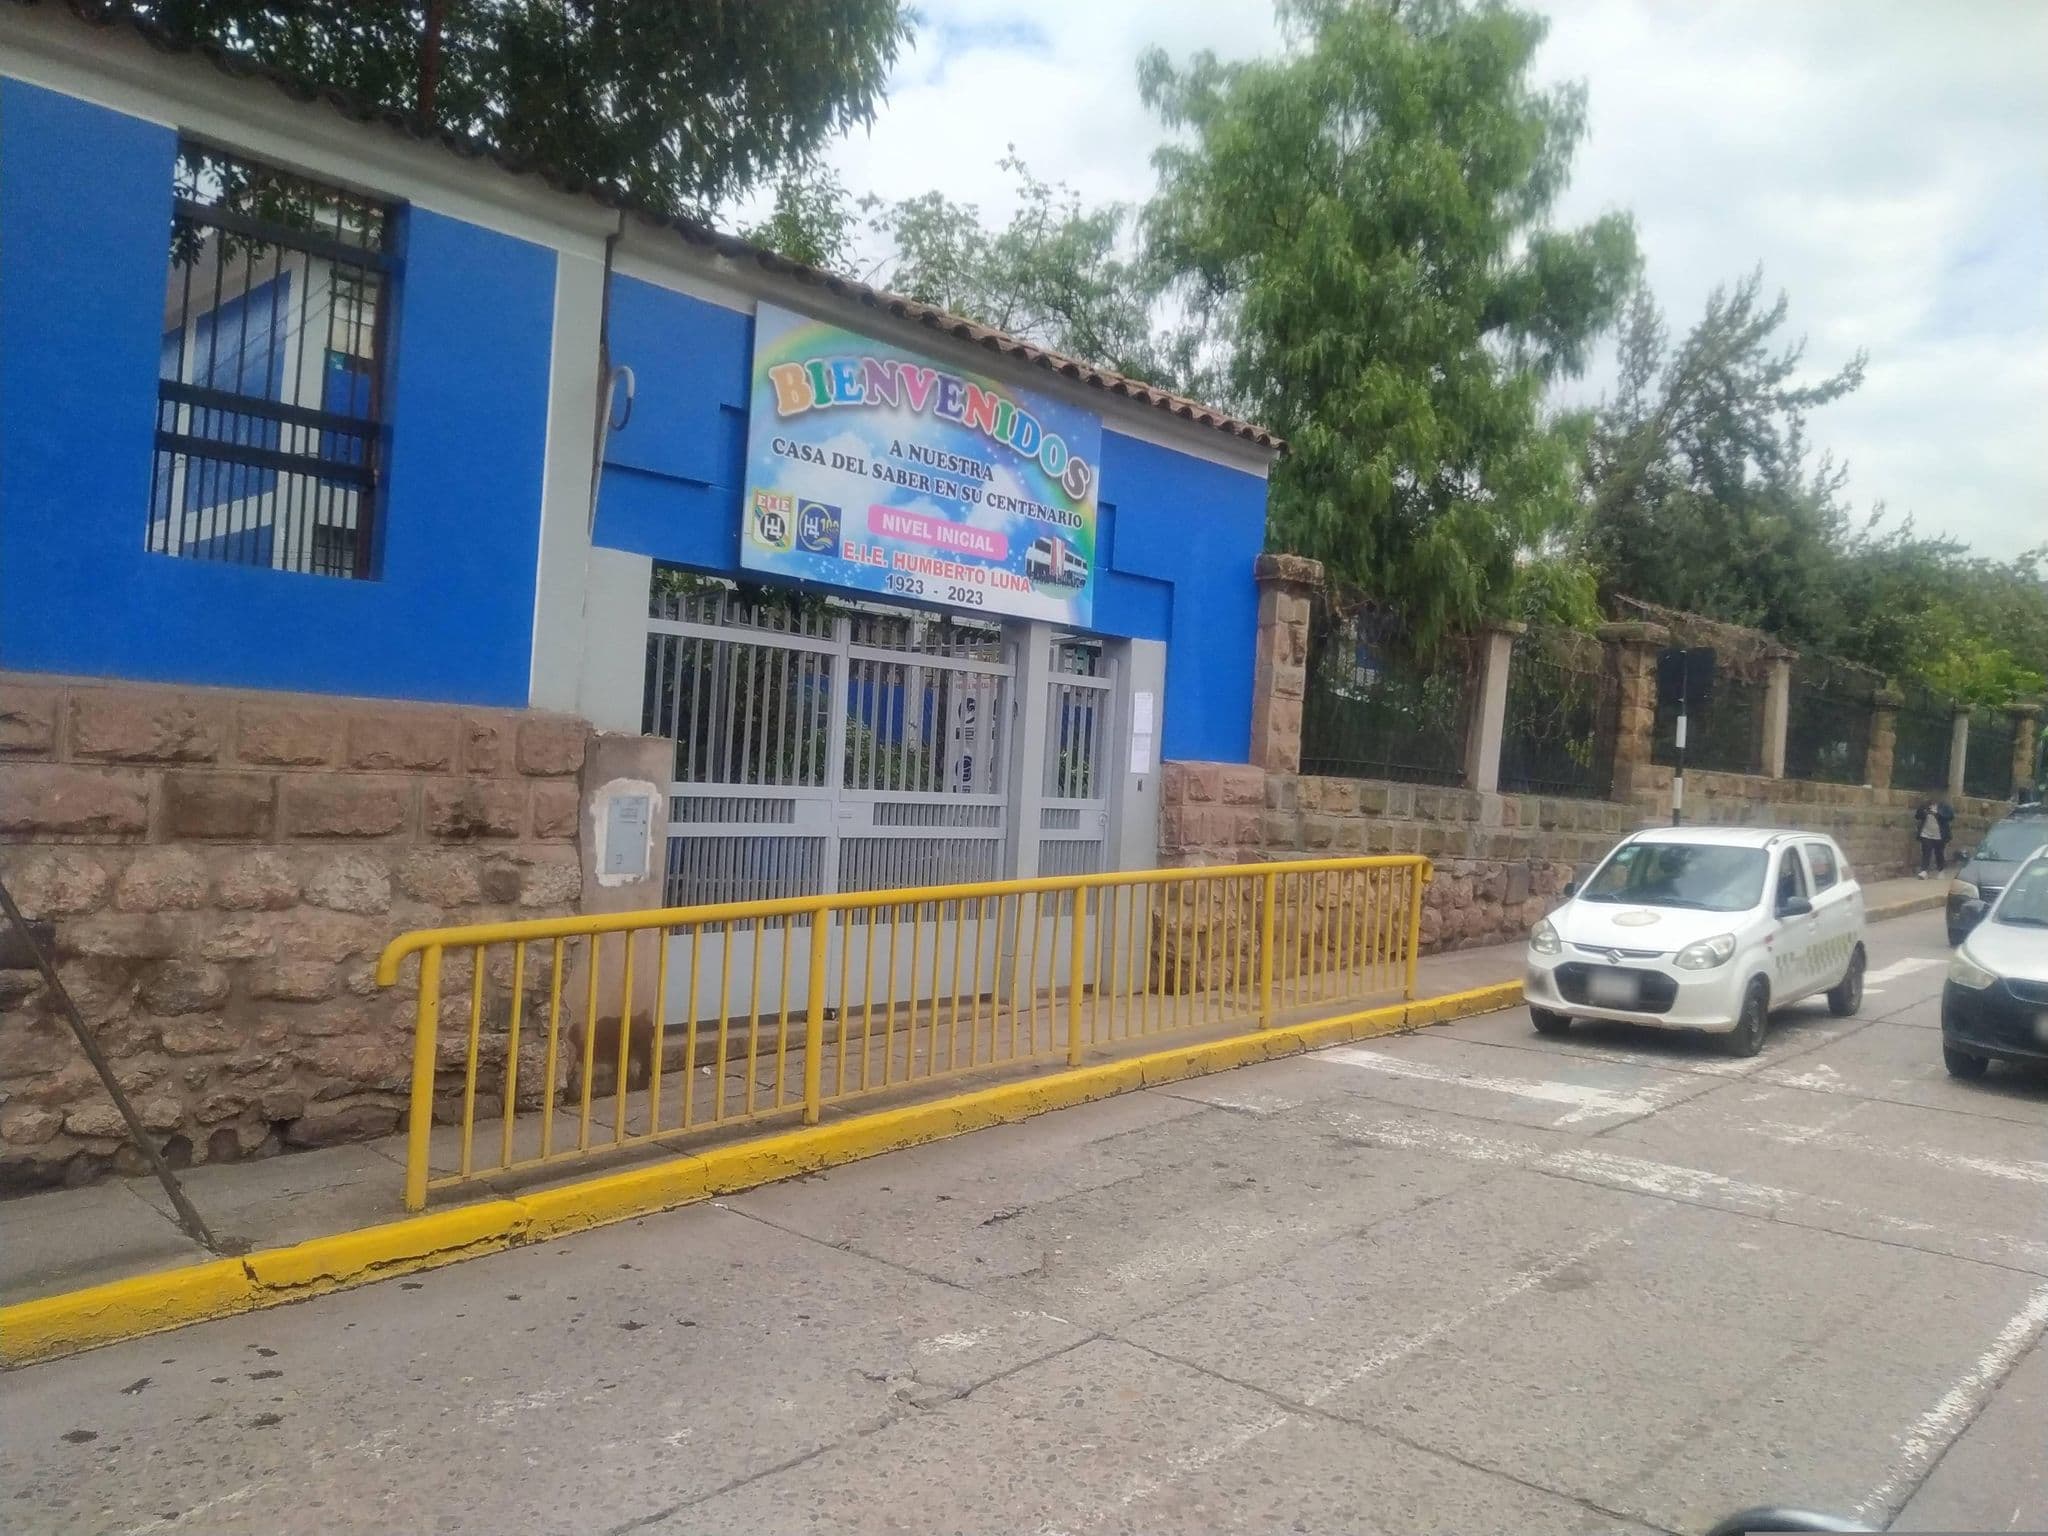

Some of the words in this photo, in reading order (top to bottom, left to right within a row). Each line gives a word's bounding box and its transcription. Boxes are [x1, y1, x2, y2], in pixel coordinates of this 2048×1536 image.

[769, 356, 1091, 500] BIENVENIDOS
[772, 438, 826, 466] CASA
[831, 452, 868, 476] DEL
[872, 463, 930, 492] SABER
[935, 480, 957, 498] EN
[961, 487, 982, 504] SU
[986, 493, 1083, 528] CENTENARIO
[889, 440, 903, 458] A
[909, 444, 994, 481] NUESTRA
[882, 512, 932, 541] NIVEL
[936, 525, 995, 553] INICIAL
[843, 542, 888, 566] E.I.E.
[893, 551, 986, 585] HUMBERTO
[990, 572, 1031, 594] LUNA
[886, 575, 924, 595] 1923
[948, 585, 984, 606] 2023
